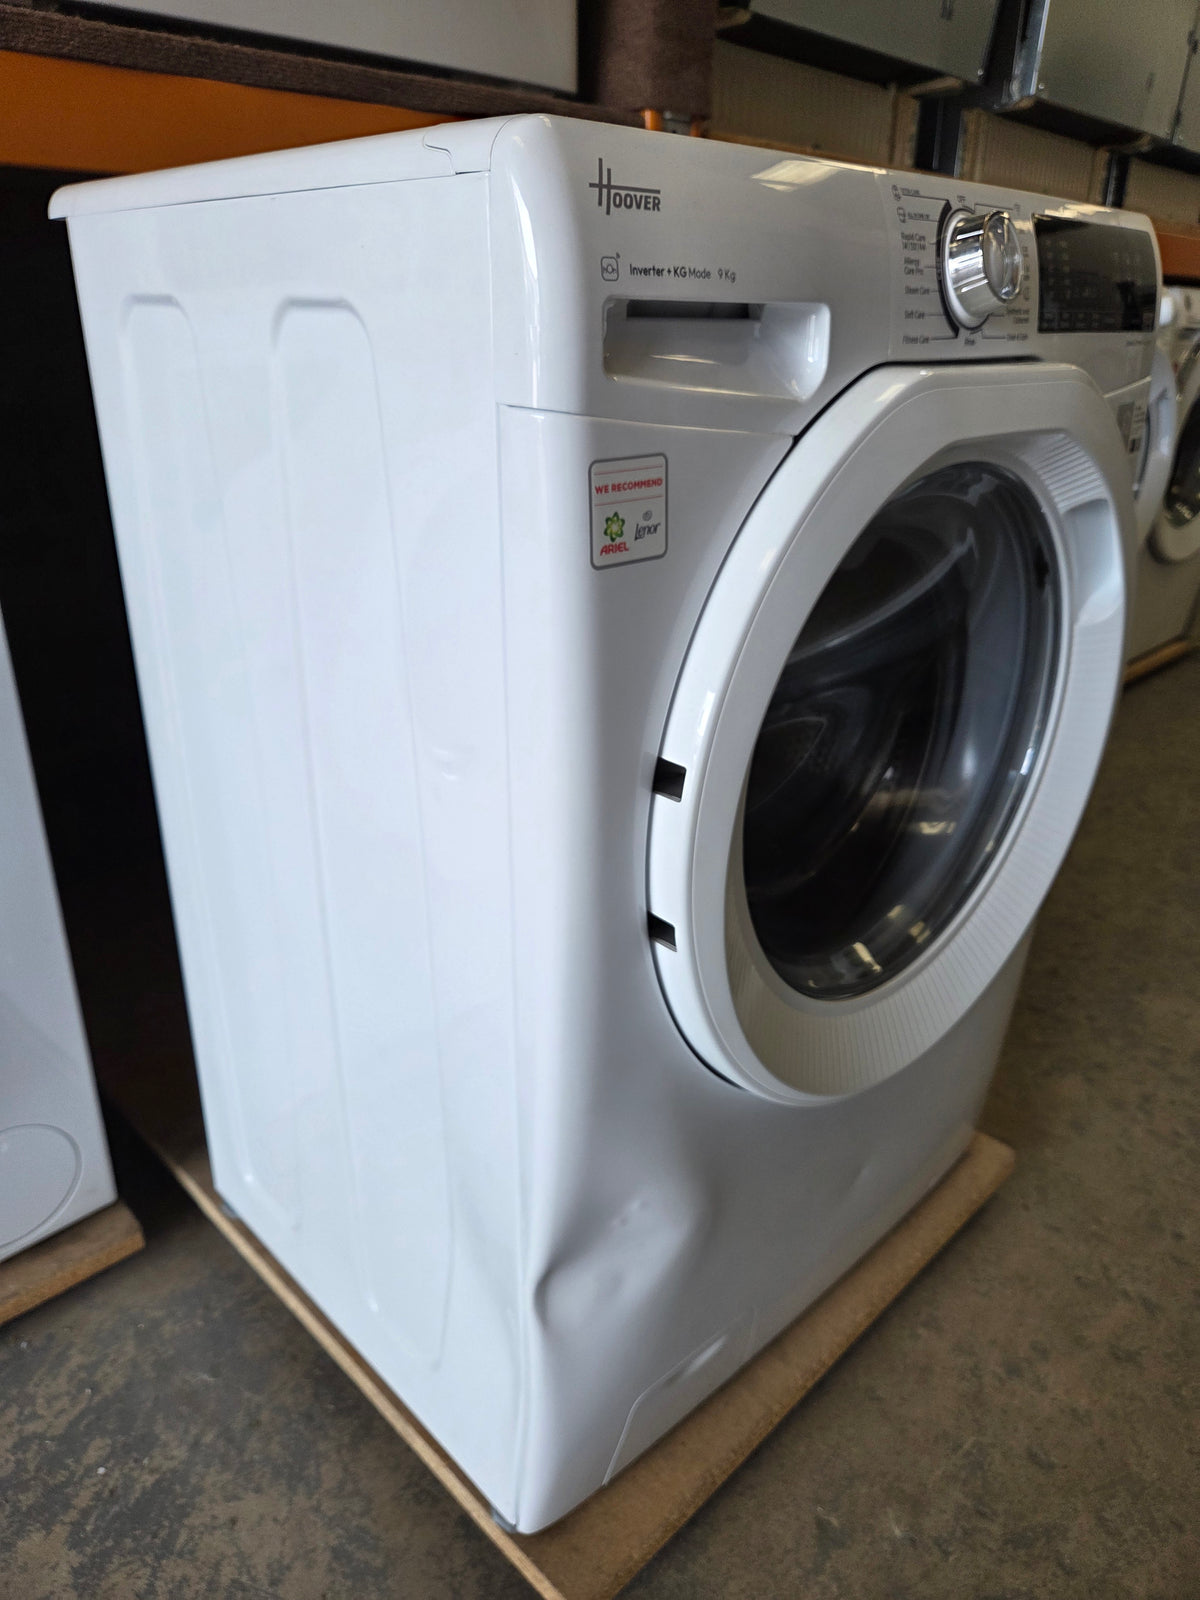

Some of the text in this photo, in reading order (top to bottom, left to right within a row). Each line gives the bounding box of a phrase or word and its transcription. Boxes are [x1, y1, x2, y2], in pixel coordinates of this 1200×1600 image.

[589, 158, 661, 215] HOOVER
[629, 263, 664, 277] Inverter
[673, 266, 687, 278] KG
[688, 268, 711, 279] Mode
[595, 478, 663, 494] WE RECOMMEND
[634, 522, 661, 541] Lenor
[600, 541, 629, 556] ARIEL
